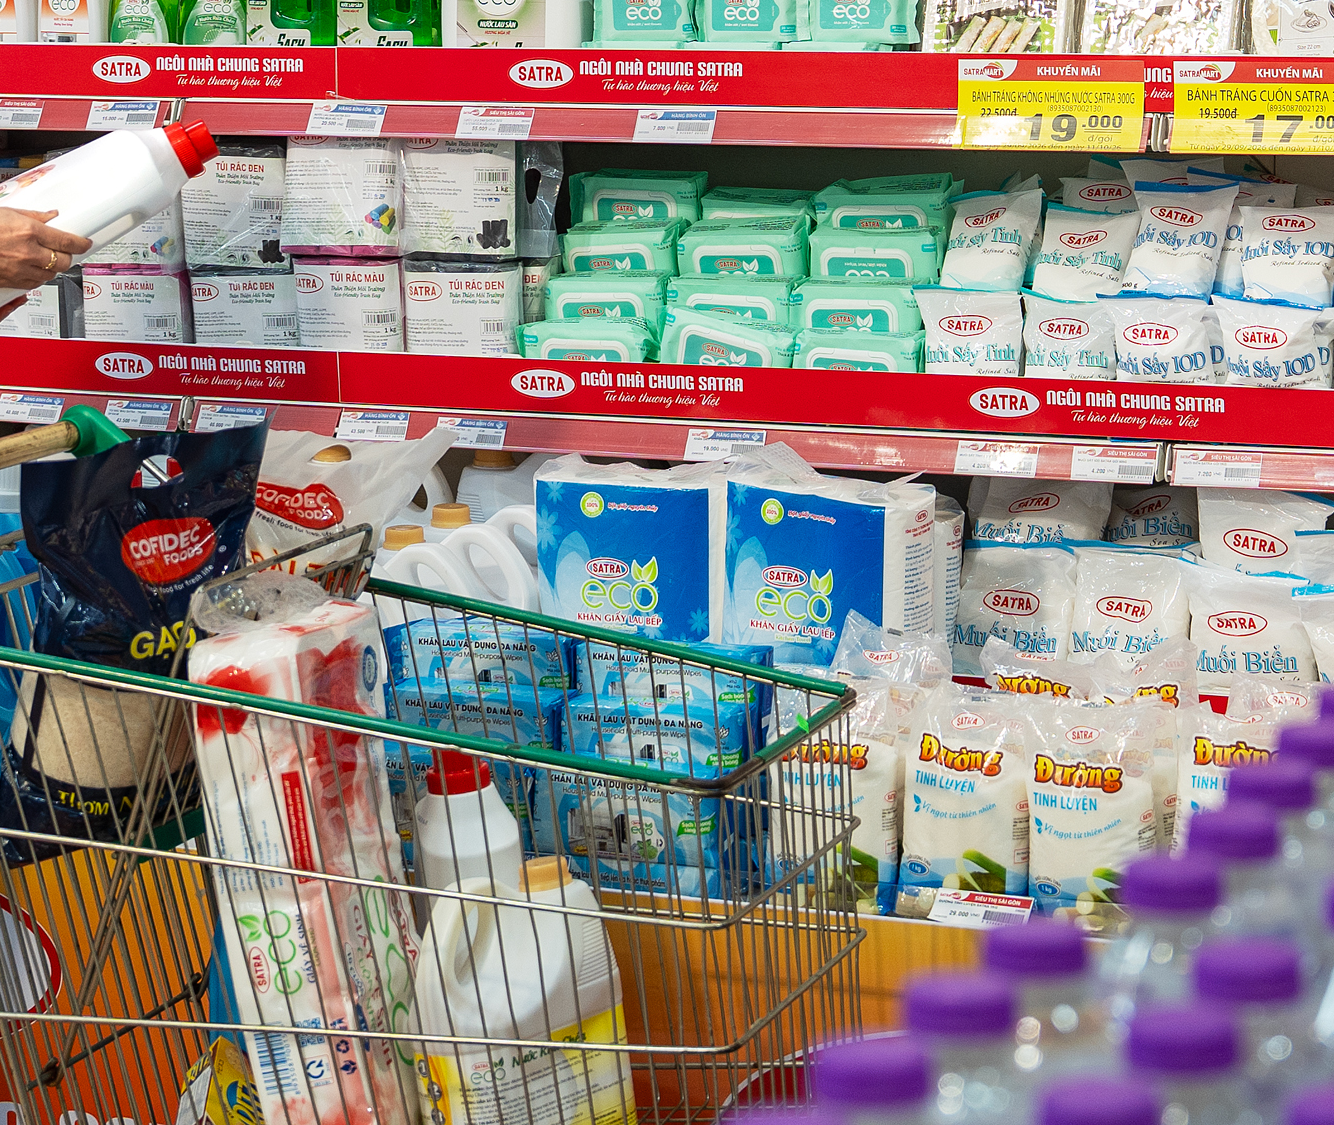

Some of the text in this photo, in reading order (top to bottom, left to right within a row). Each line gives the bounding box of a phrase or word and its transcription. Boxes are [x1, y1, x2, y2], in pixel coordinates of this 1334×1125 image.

[626, 5, 661, 21] eco
[1256, 66, 1323, 79] KHUYẾN MÃI
[972, 89, 1135, 104] BÁNH TRÁNG KHÔNG NHÚNG NƯỚC SATRA 300G
[1187, 89, 1217, 101] BÁNH
[1220, 90, 1256, 102] TRÁNG
[1260, 88, 1292, 102] CUỐN
[1295, 91, 1329, 102] SATRA
[1245, 114, 1303, 143] 17
[330, 271, 385, 283] TÚI RÁC MÀU
[449, 279, 505, 290] TÚI RÁC ĐEN
[409, 286, 436, 296] SATRA
[593, 563, 622, 574] SATRA
[581, 579, 658, 612] eco
[577, 611, 662, 626] KHĂN GIẤY LAU BẾP
[1216, 617, 1257, 630] SATRA
[1245, 646, 1299, 673] Biển
[1034, 754, 1123, 793] Đường
[1033, 792, 1098, 814] TINH LUYỆN
